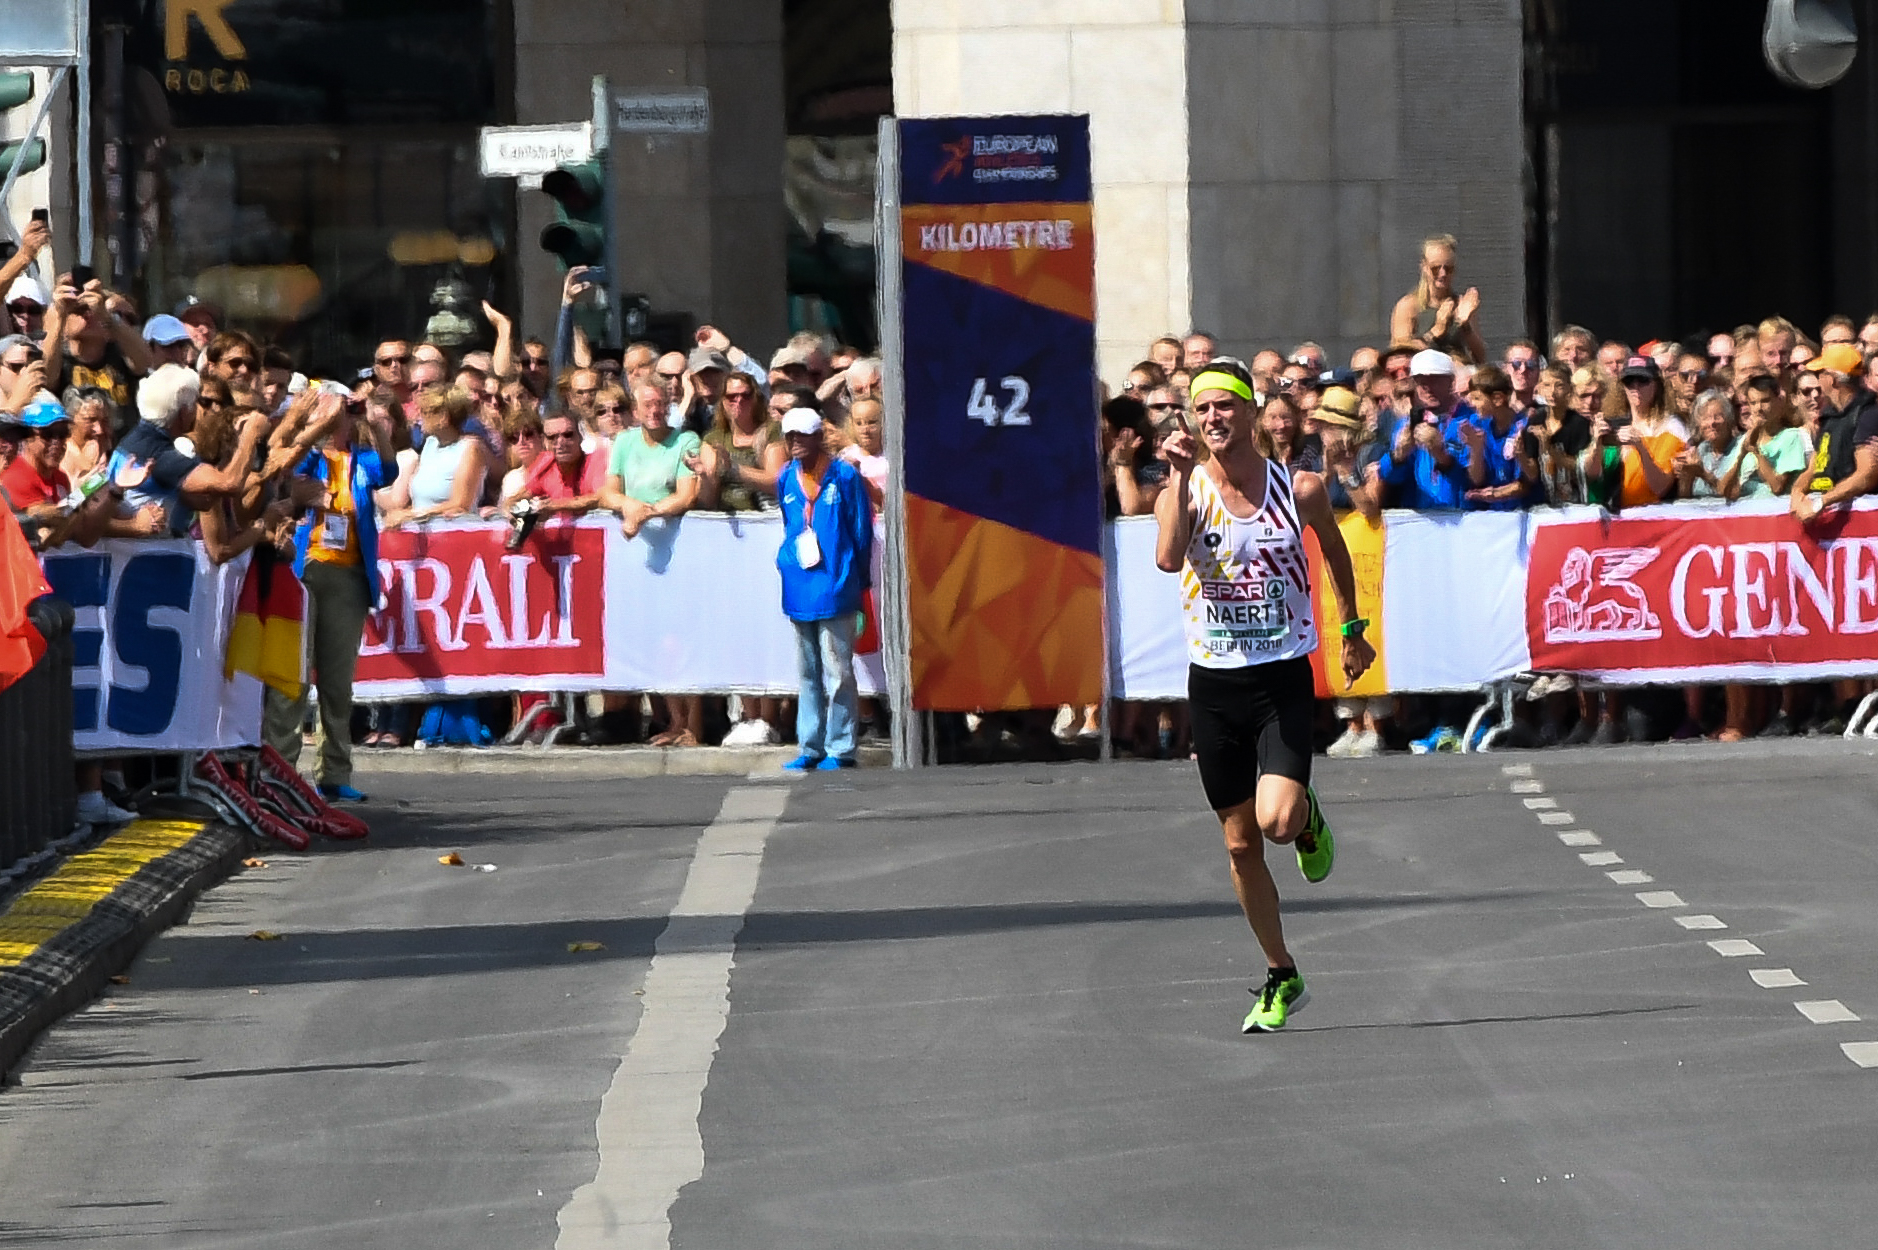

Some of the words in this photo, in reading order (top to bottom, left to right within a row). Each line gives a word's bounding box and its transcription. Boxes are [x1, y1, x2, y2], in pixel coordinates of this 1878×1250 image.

[921, 220, 1074, 252] KILOMETRE
[967, 375, 1031, 426] 42
[1203, 584, 1264, 600] SPAR
[1669, 537, 1878, 639] GENE
[1206, 604, 1272, 624] NAERT
